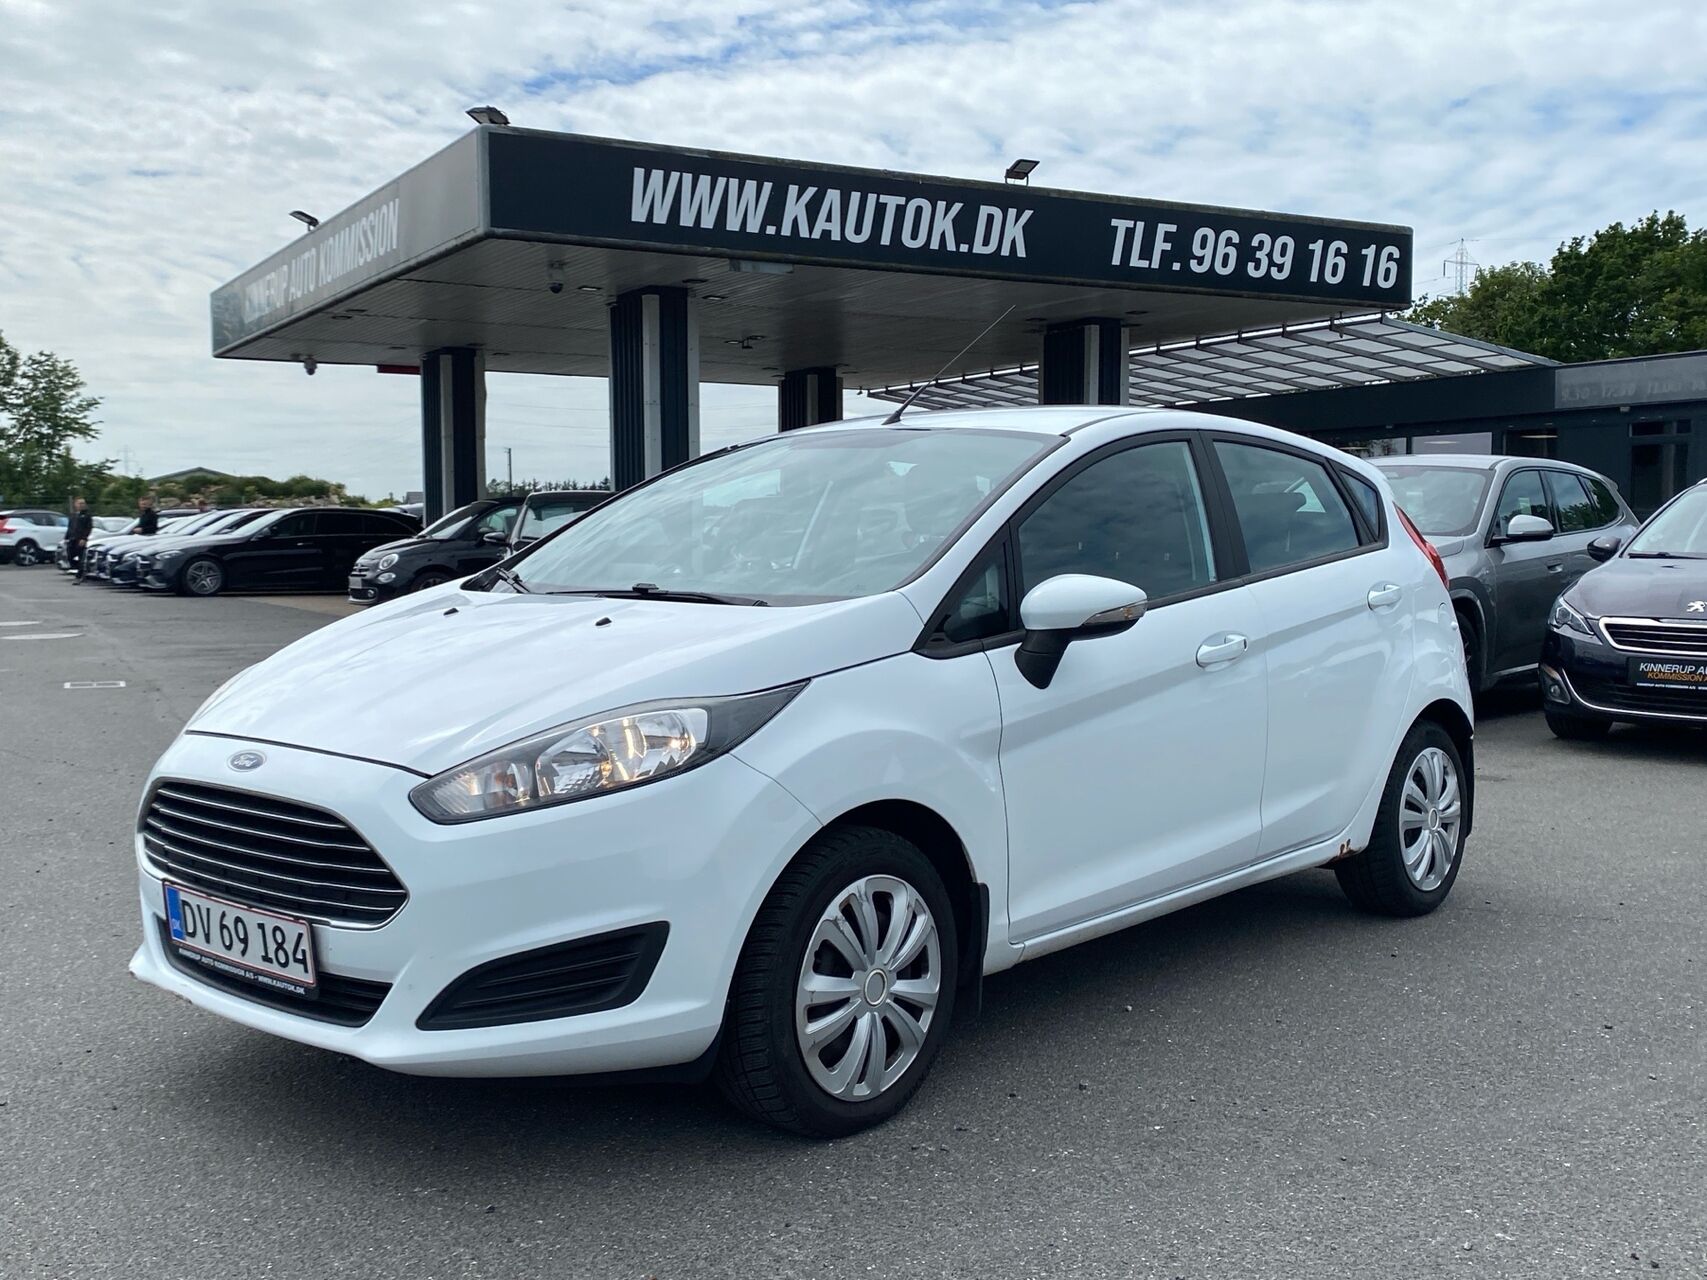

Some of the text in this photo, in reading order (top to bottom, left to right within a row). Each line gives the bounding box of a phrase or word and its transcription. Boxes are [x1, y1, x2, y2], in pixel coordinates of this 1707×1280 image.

[631, 166, 1034, 258] WWW.KAUTOK.DK
[288, 247, 317, 301] AUTO
[318, 198, 400, 287] KOMMISSION
[1110, 218, 1400, 289] TLF. 96 39 16 16
[1639, 663, 1707, 674] KINNERUP A
[1648, 672, 1702, 681] KOMMISSION
[181, 899, 309, 974] DV 69 184
